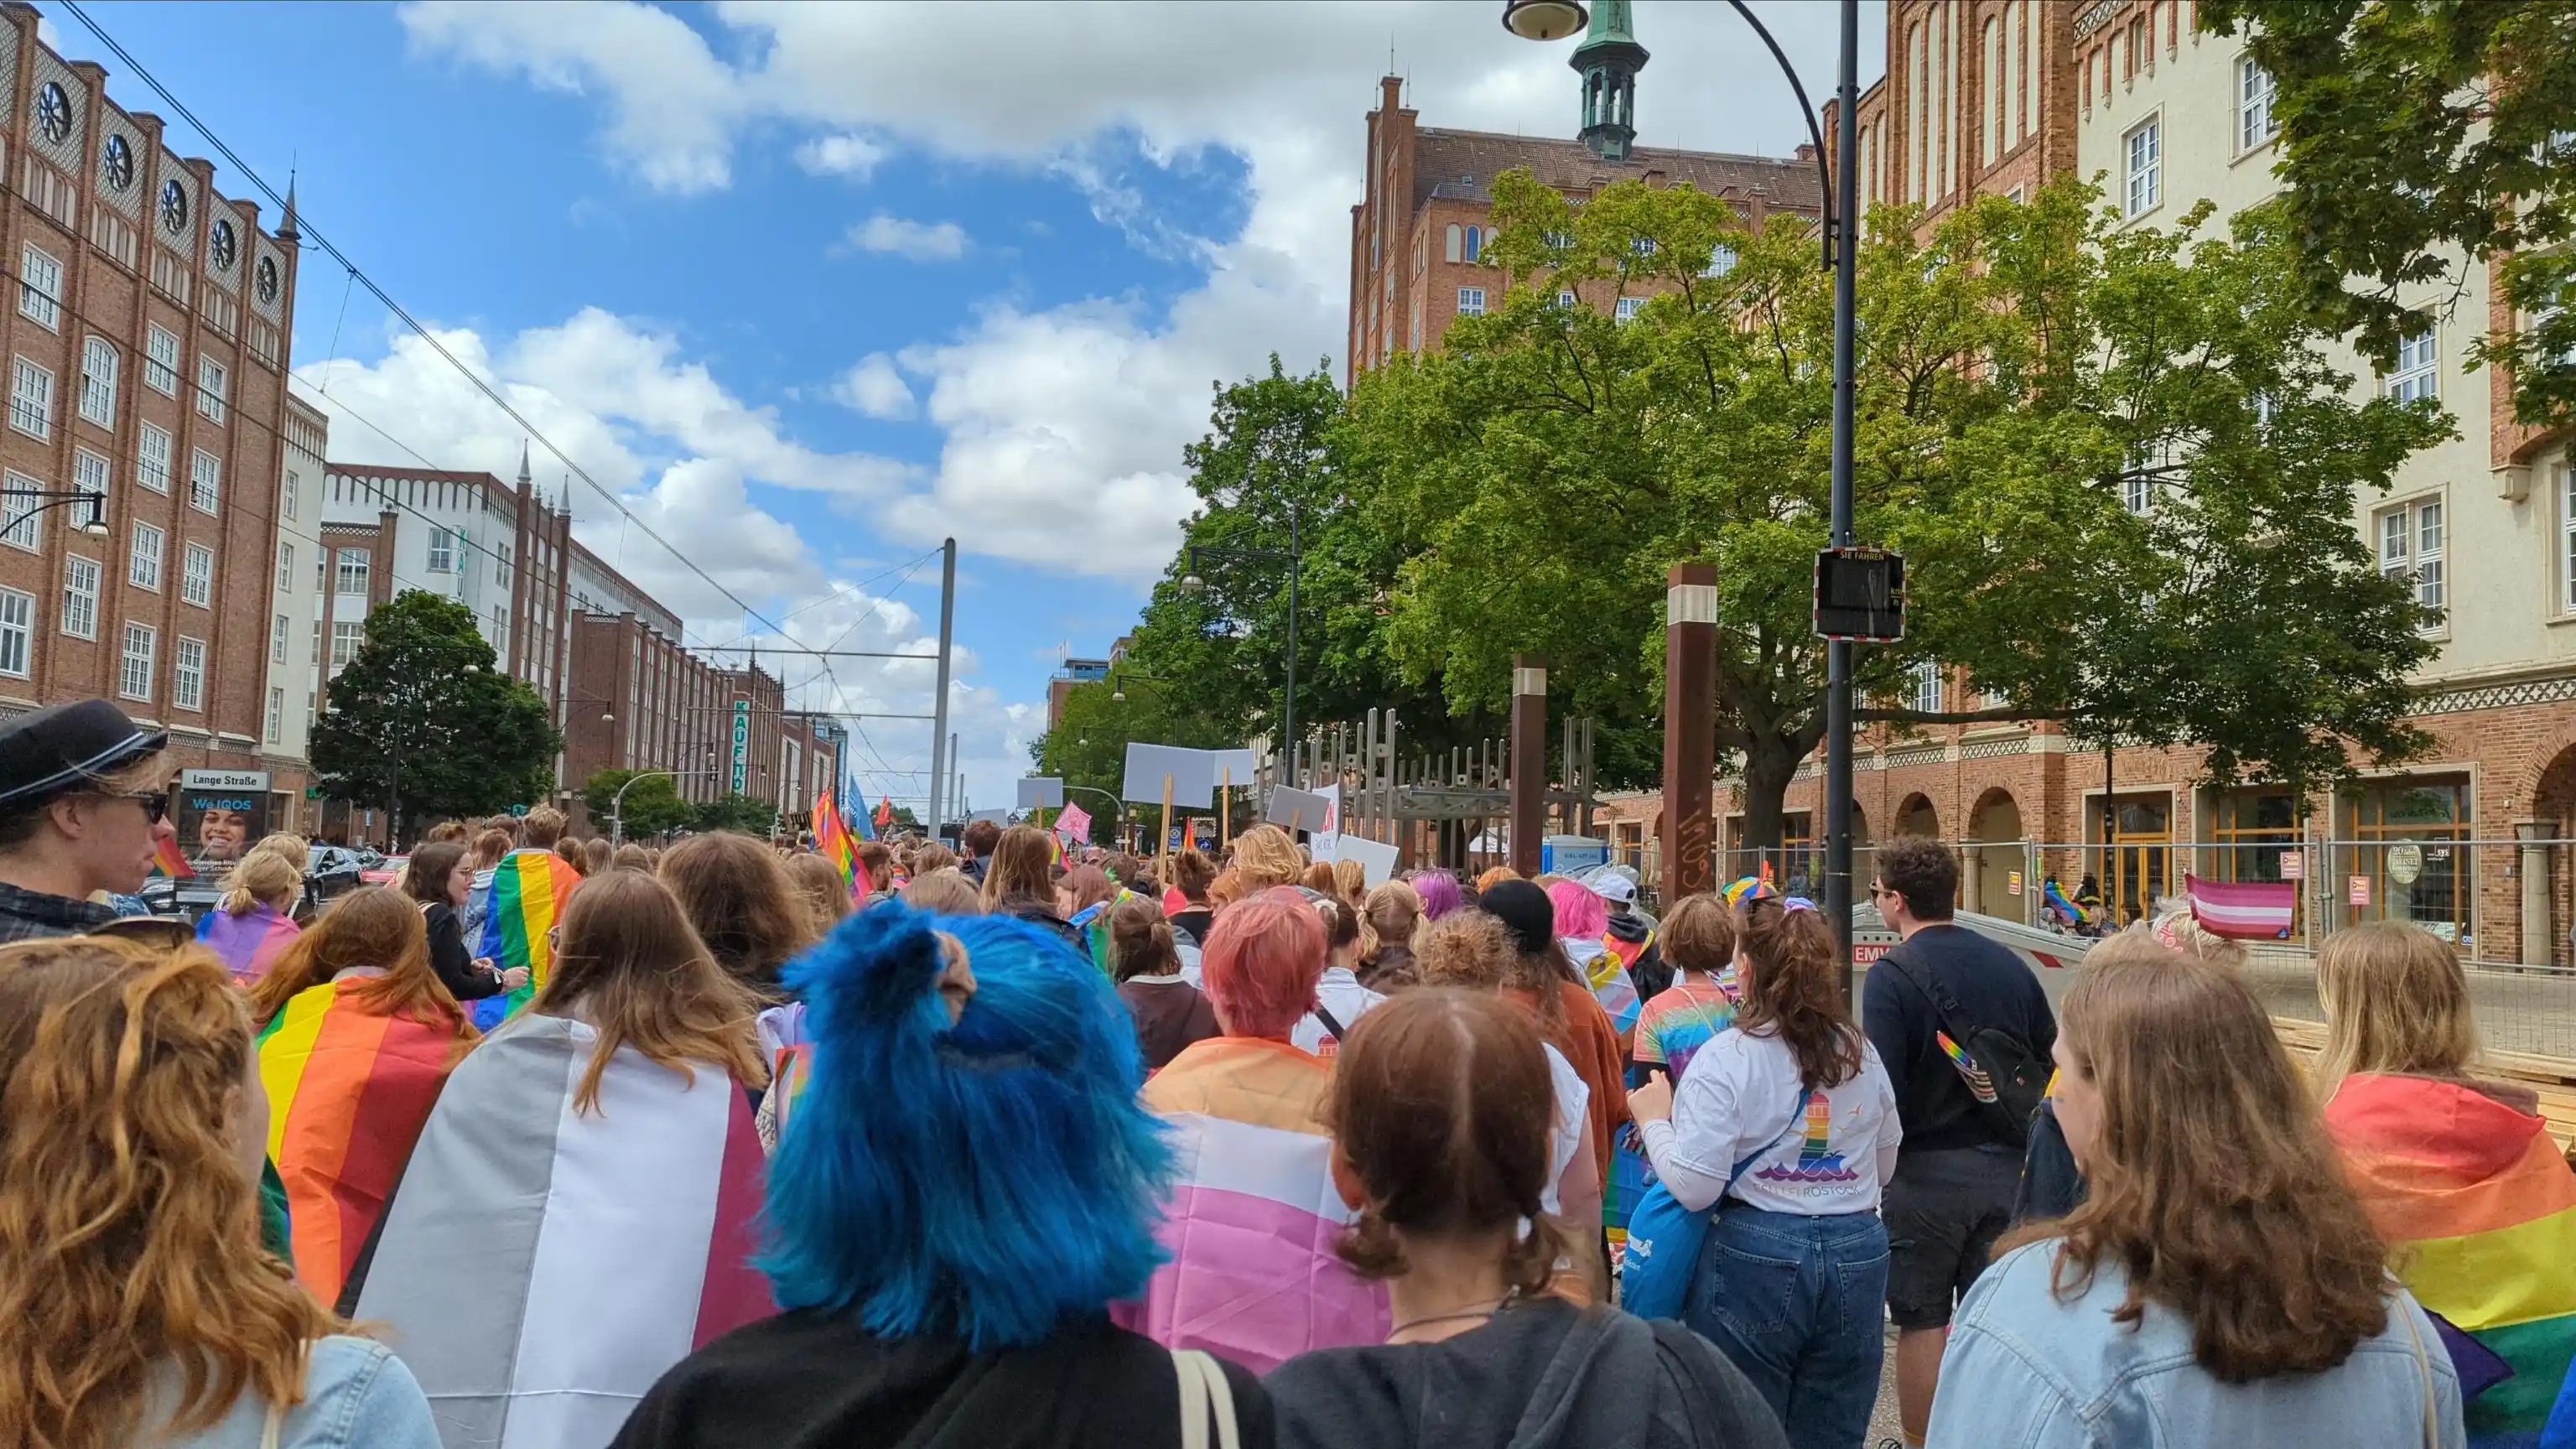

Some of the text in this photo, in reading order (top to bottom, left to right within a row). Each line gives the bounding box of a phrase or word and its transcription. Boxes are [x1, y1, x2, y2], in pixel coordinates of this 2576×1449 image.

[1840, 551, 1884, 560] SIE FAHREN
[193, 774, 257, 786] Lange Straße
[217, 799, 252, 810] IQOS
[1803, 1185, 1861, 1197] ROSTOCK
